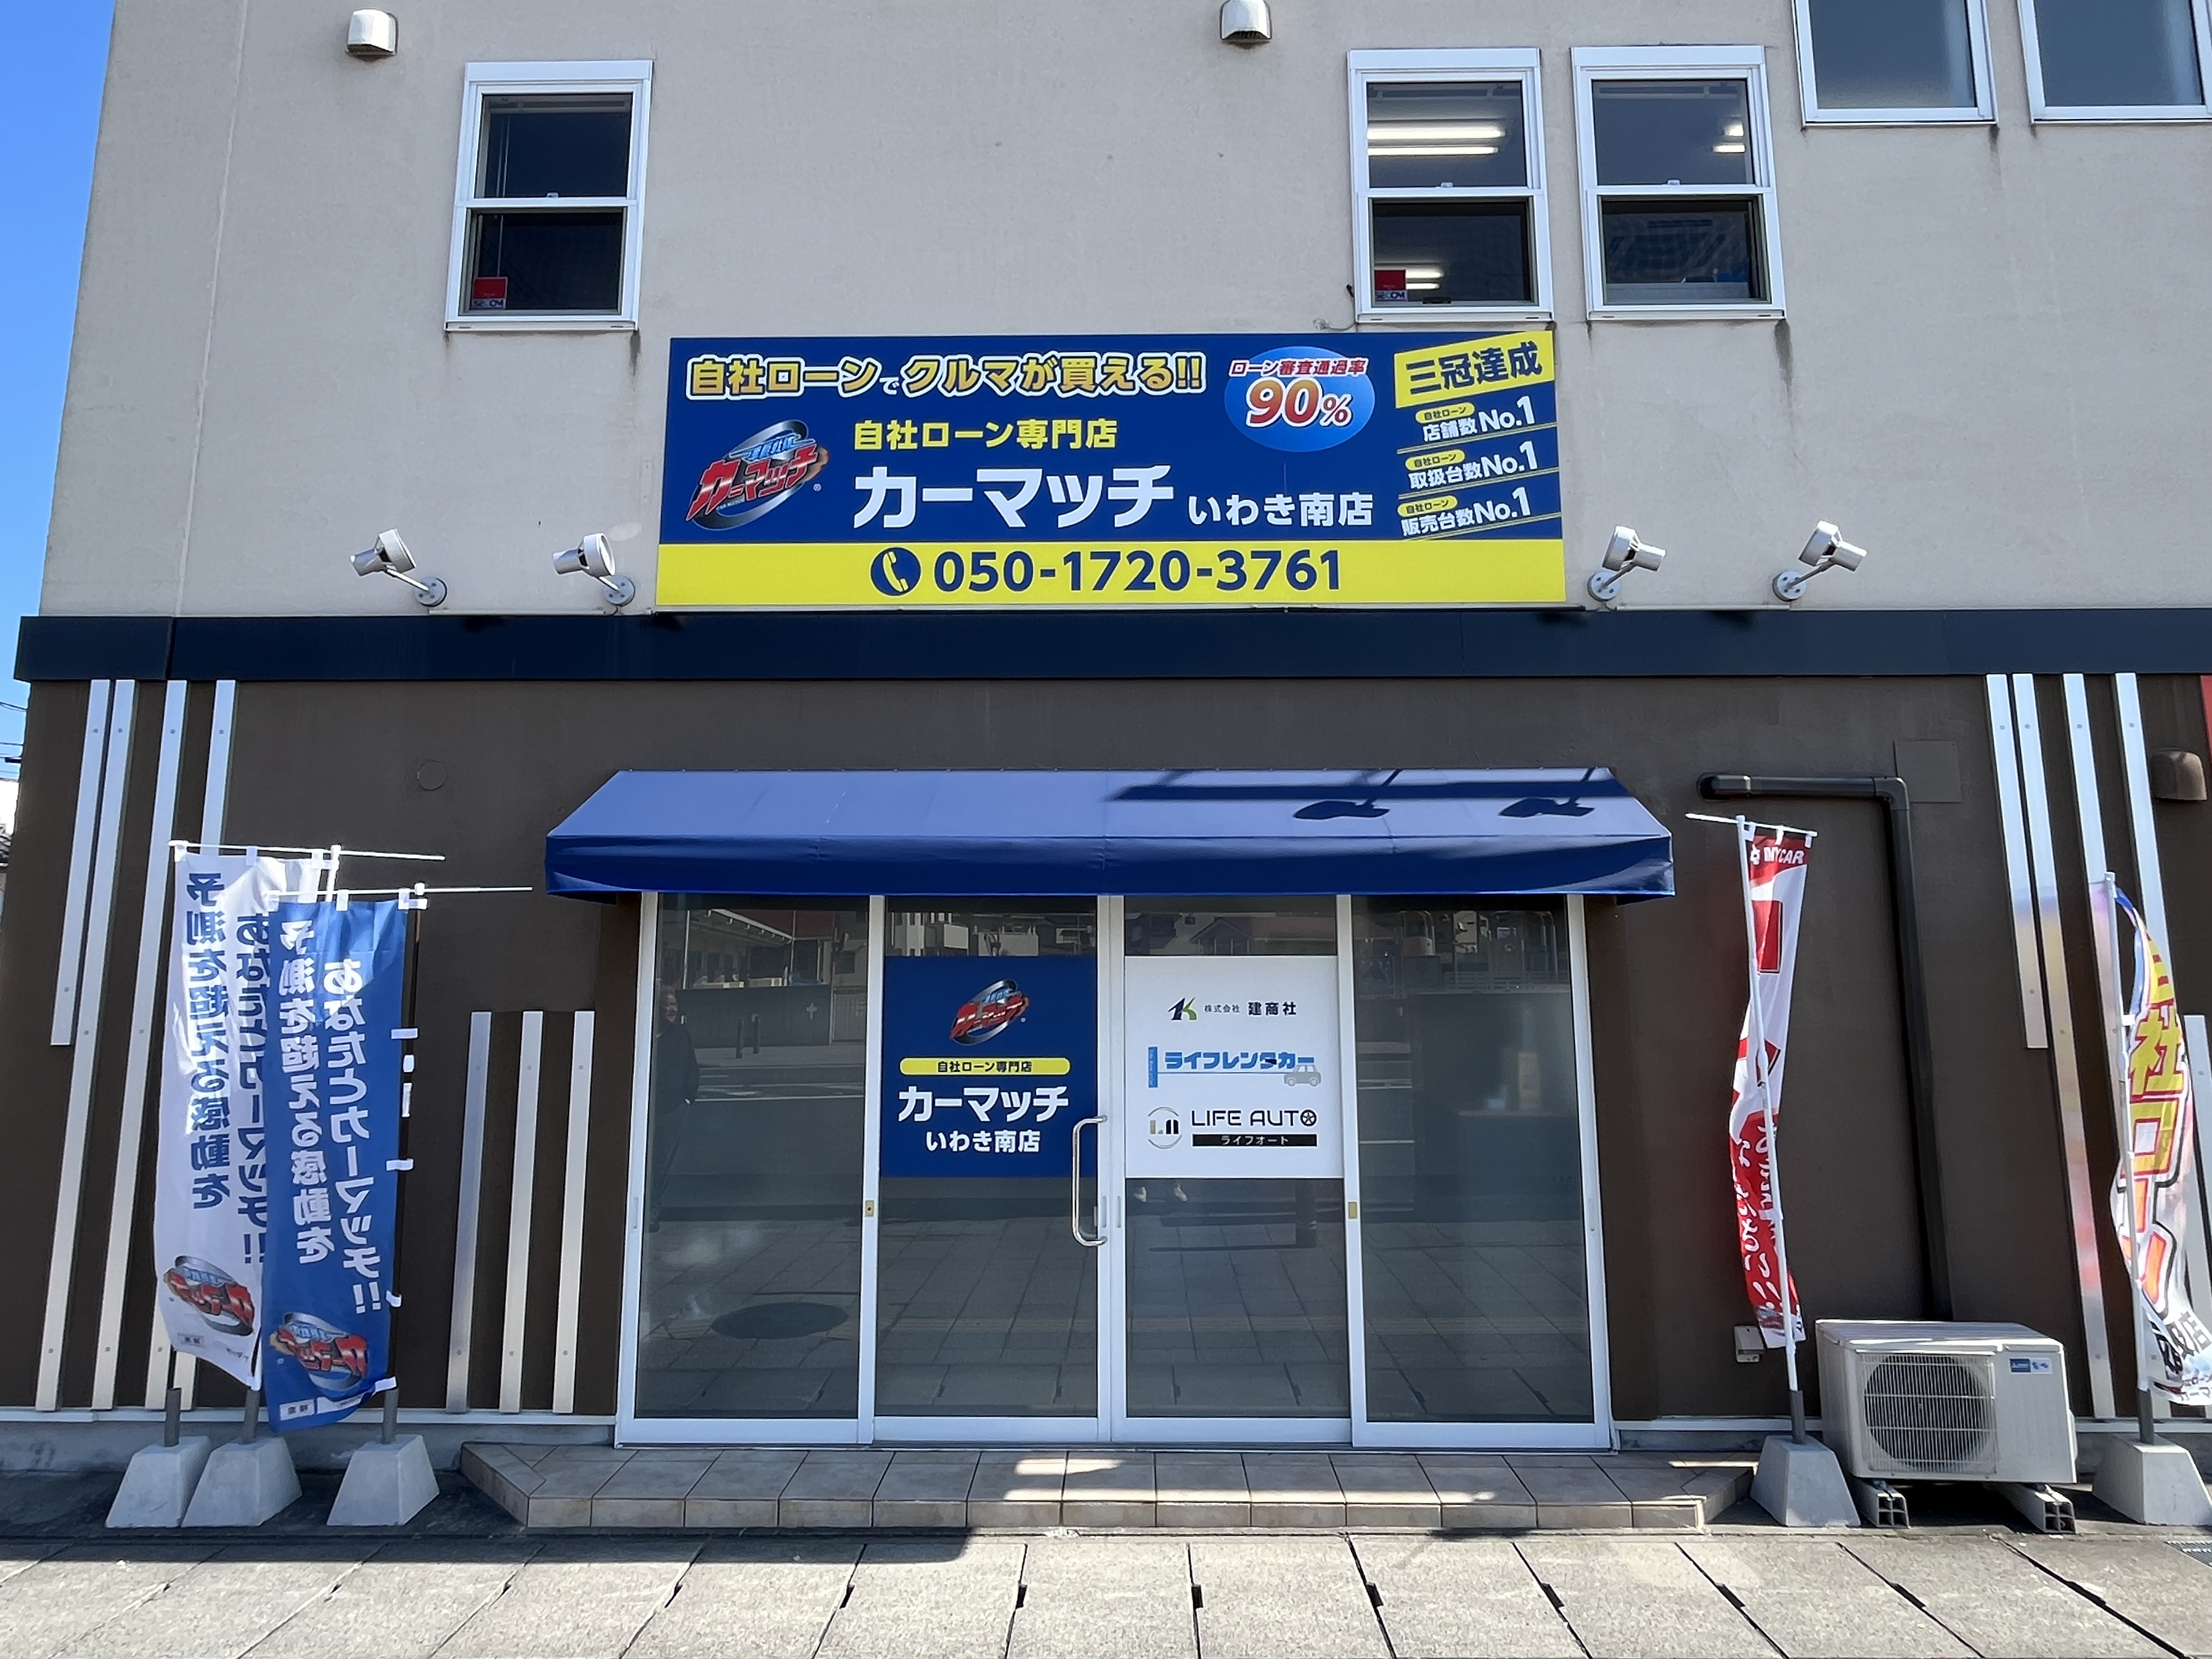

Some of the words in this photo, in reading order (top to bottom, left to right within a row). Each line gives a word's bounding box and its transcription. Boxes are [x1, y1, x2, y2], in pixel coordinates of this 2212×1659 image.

[686, 351, 1206, 400] 自社ローンでクルマが買える!!
[1229, 358, 1368, 377] ローン審査通過率
[1406, 341, 1542, 395] 三冠達成
[1246, 377, 1353, 427] 90%
[1423, 406, 1467, 421] 自社ローン
[854, 419, 1117, 450] 自社ローン専門店
[1414, 453, 1456, 468] 自社ローン
[853, 464, 1173, 530] カーマッチ
[1187, 493, 1373, 527] いわき南店
[1406, 499, 1449, 514] 自社ローン
[934, 549, 1341, 593] 050-1720-3761
[1204, 1004, 1241, 1014] 株式会社
[1248, 1002, 1297, 1016] 建商社
[937, 1061, 1032, 1073] 自社ローン専門店
[1164, 1051, 1315, 1070] ライフレンタカー
[898, 1086, 1069, 1123] カーマッチ
[1191, 1110, 1242, 1126] LIFE
[926, 1129, 1041, 1153] いわき南店
[1221, 1135, 1289, 1145] ライフオート
